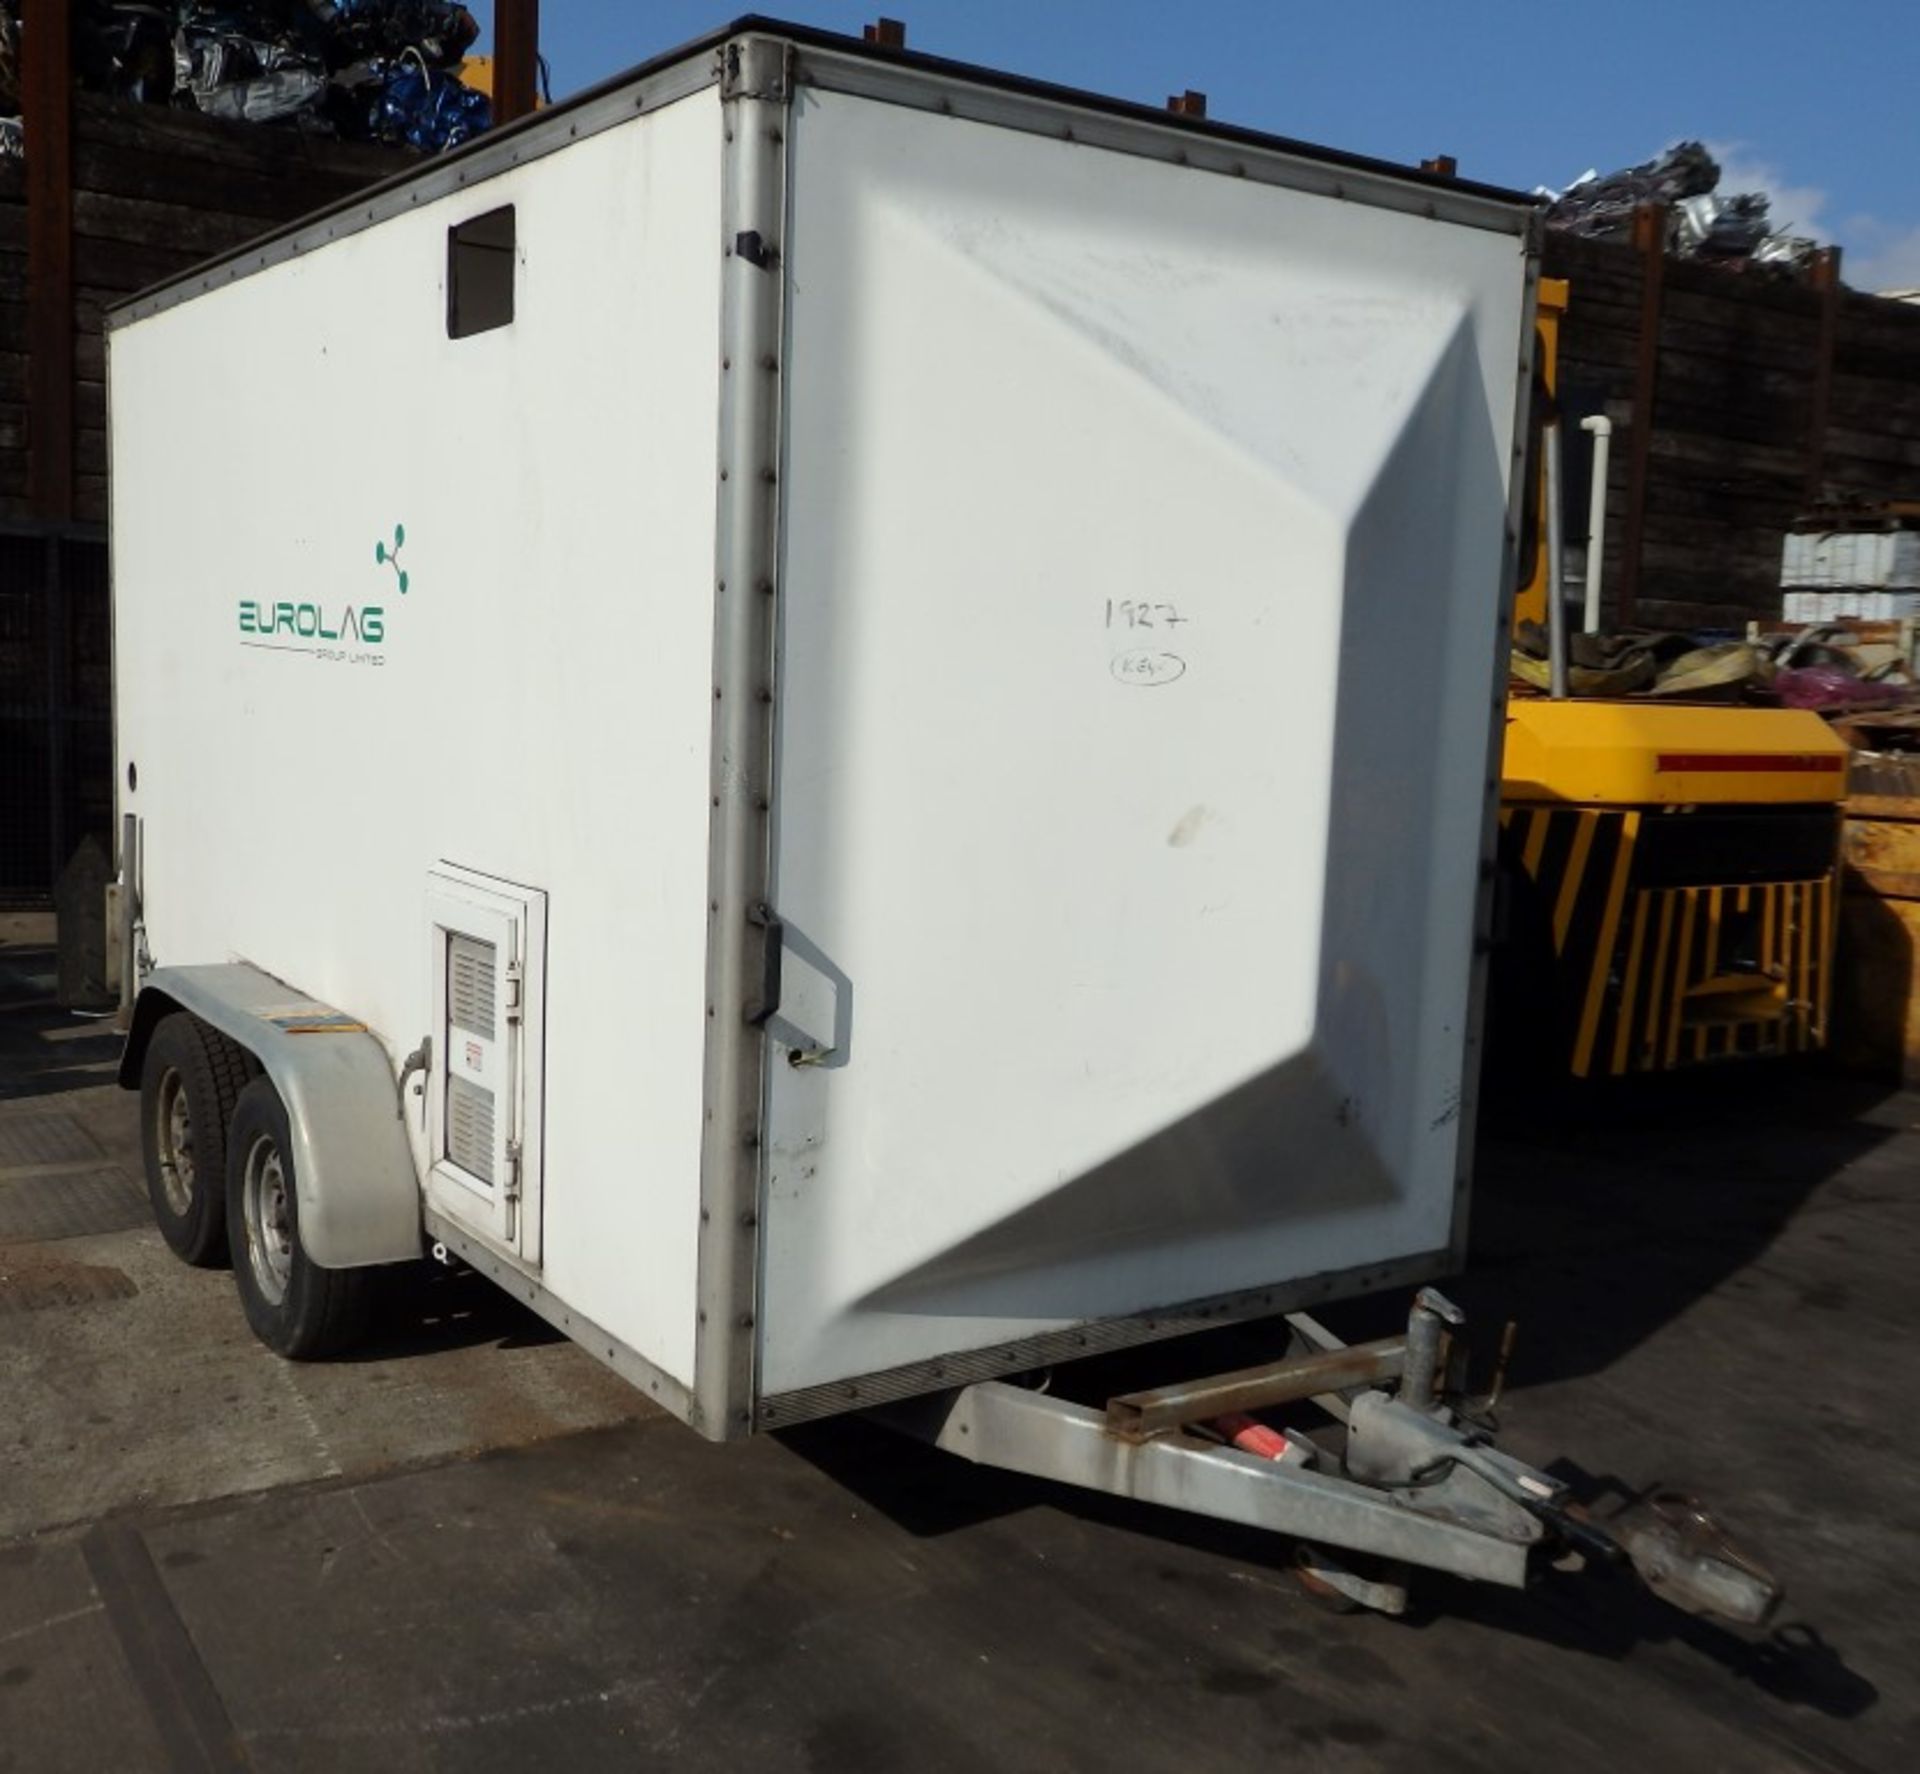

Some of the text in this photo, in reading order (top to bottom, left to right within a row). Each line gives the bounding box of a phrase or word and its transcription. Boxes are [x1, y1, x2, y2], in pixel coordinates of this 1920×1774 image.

[239, 601, 384, 643] EUROLAG
[1105, 599, 1189, 629] 1927
[316, 648, 386, 667] GROUP LIMITED
